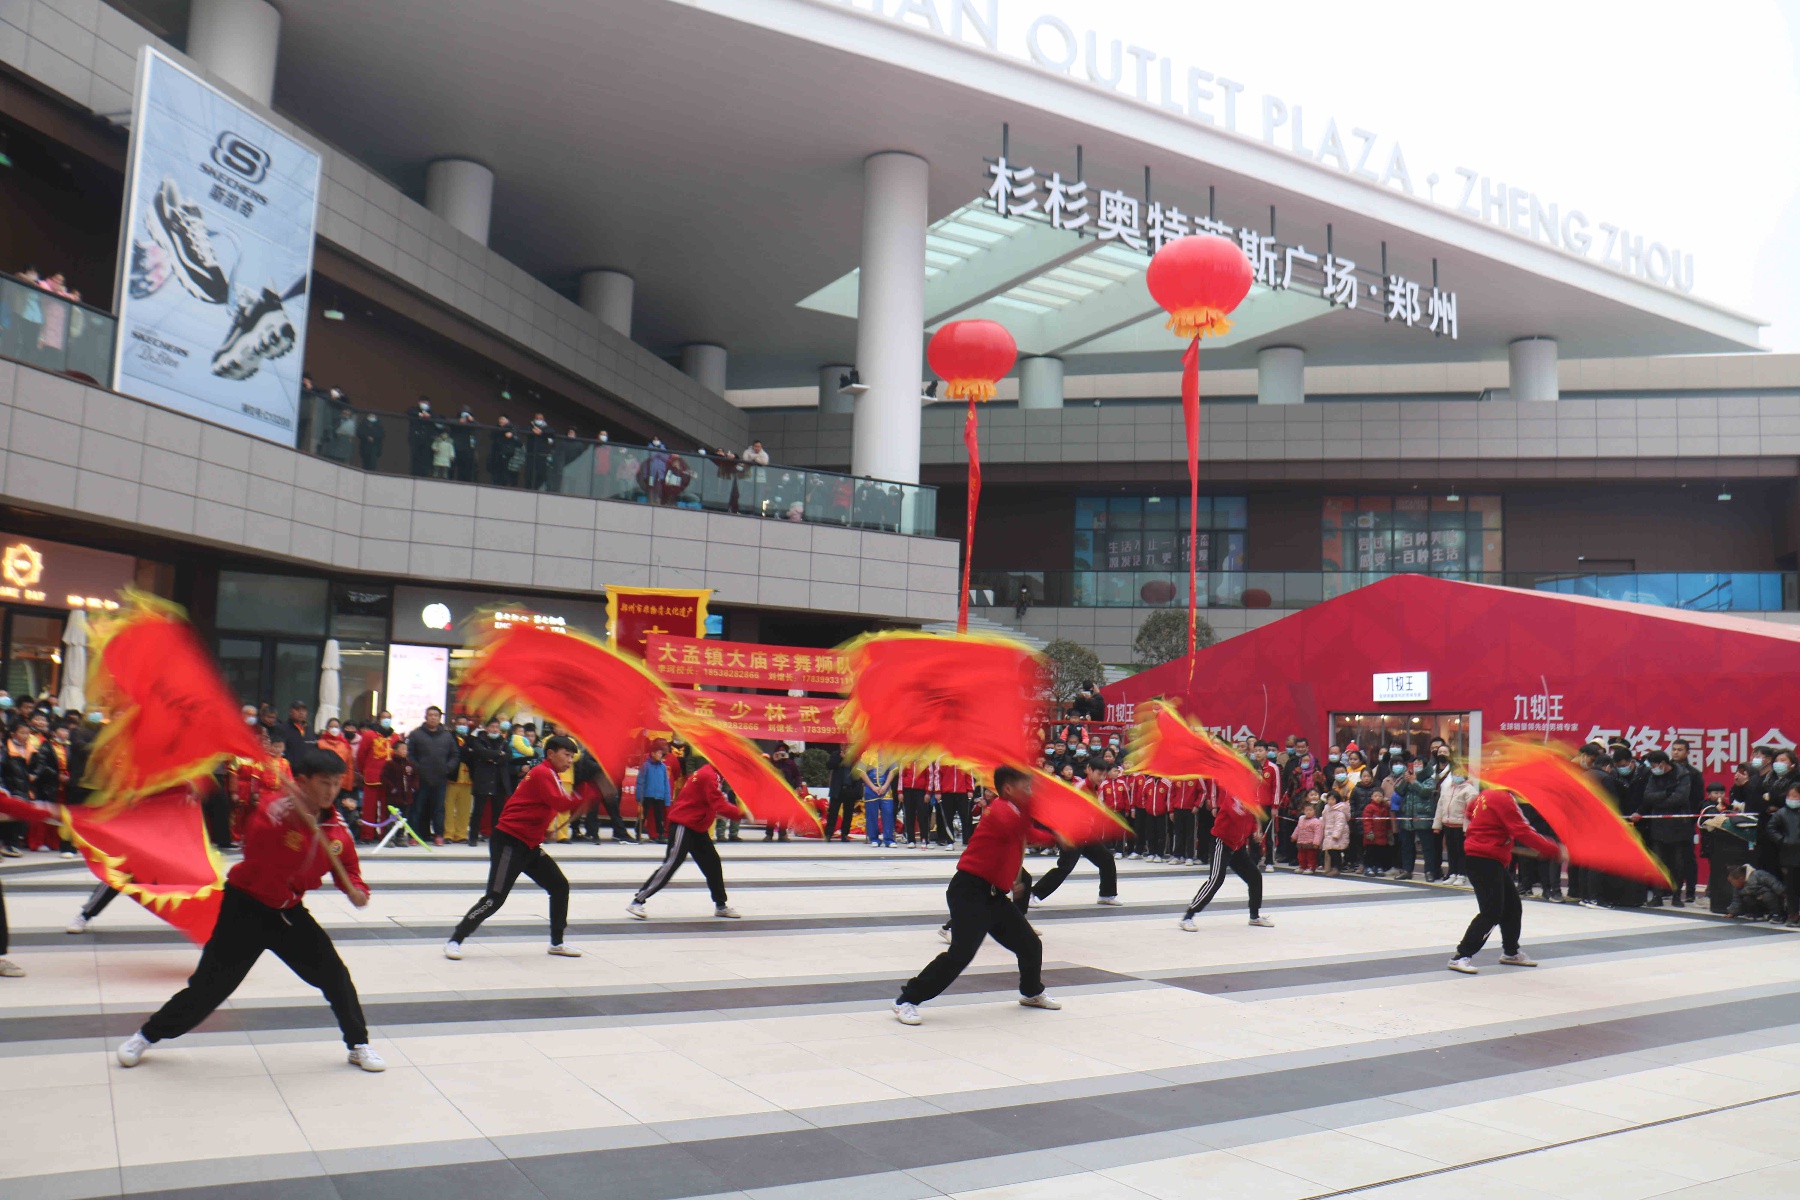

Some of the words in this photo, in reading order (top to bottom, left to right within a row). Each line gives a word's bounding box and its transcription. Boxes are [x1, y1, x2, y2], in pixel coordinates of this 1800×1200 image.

[1026, 14, 1245, 131] OUTLET
[1262, 94, 1414, 196] PLAZA
[200, 162, 268, 206] SKECHERS
[131, 330, 190, 357] SKECHERS
[658, 642, 854, 675] 大孟镇大庙李舞狮队
[1386, 676, 1413, 691] 九牧王
[1106, 703, 1135, 722] 九牧王
[1513, 694, 1564, 721] 九牧王
